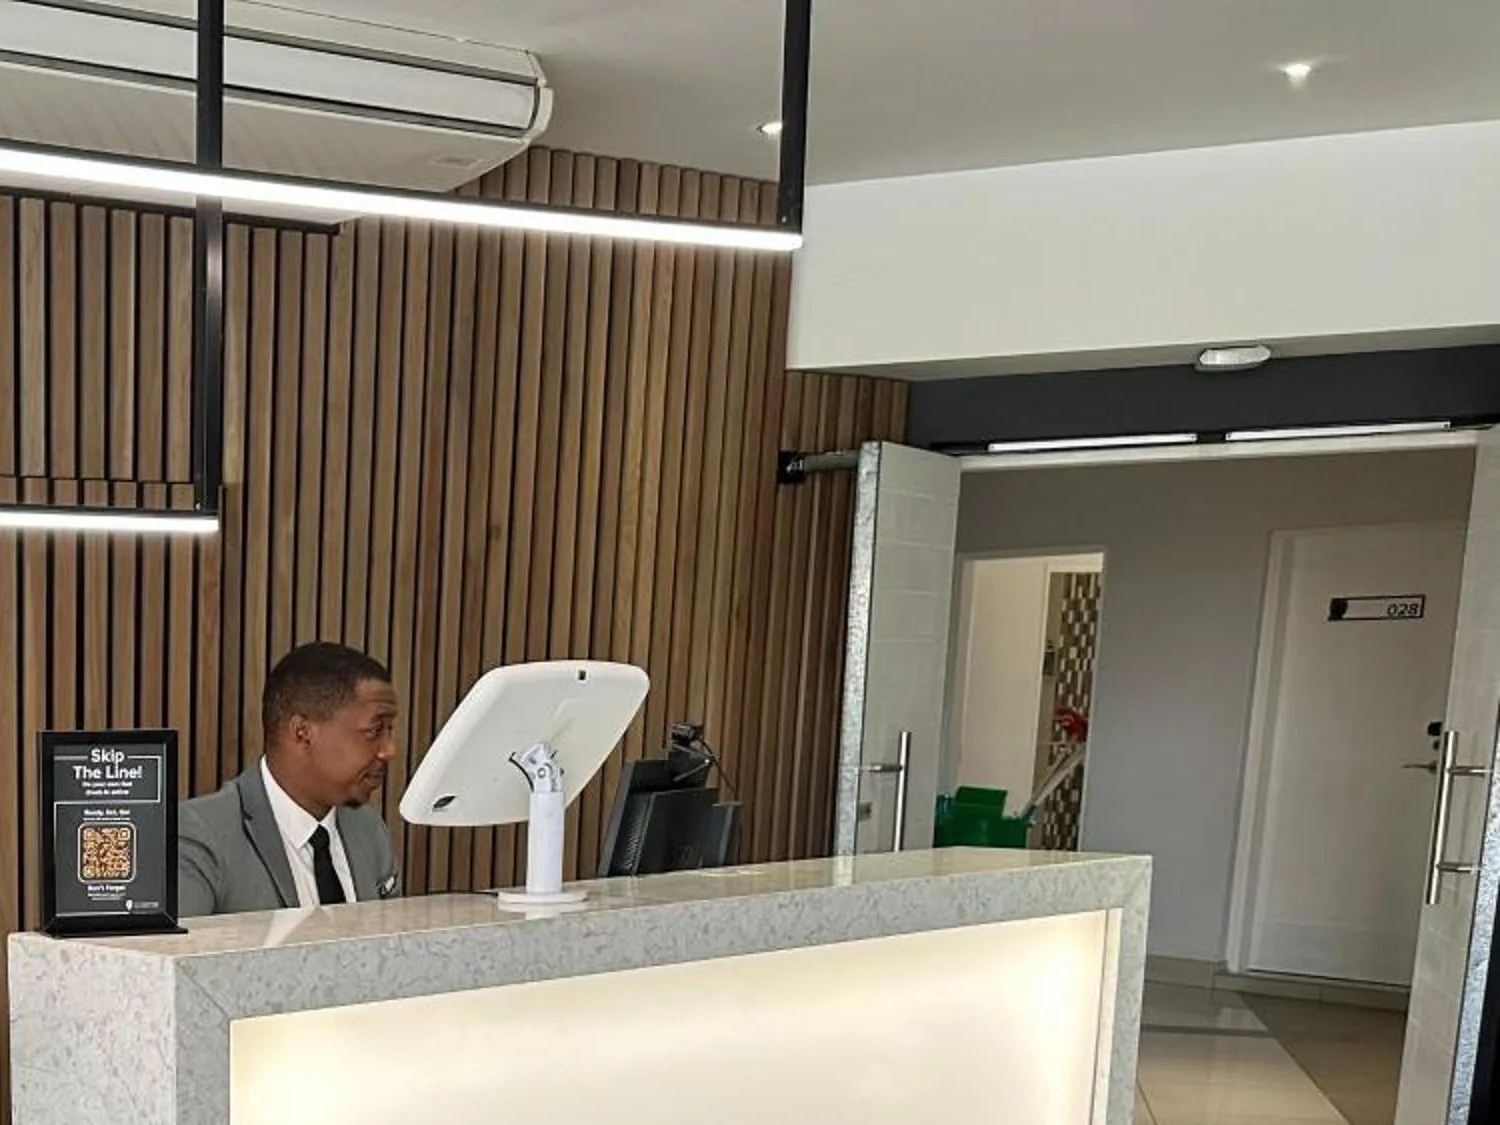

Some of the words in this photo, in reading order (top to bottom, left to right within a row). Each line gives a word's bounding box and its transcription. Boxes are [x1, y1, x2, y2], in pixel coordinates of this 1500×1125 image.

[1387, 603, 1418, 616] 028
[91, 747, 125, 765] Skip
[73, 766, 101, 779] The
[105, 765, 143, 779] Line!
